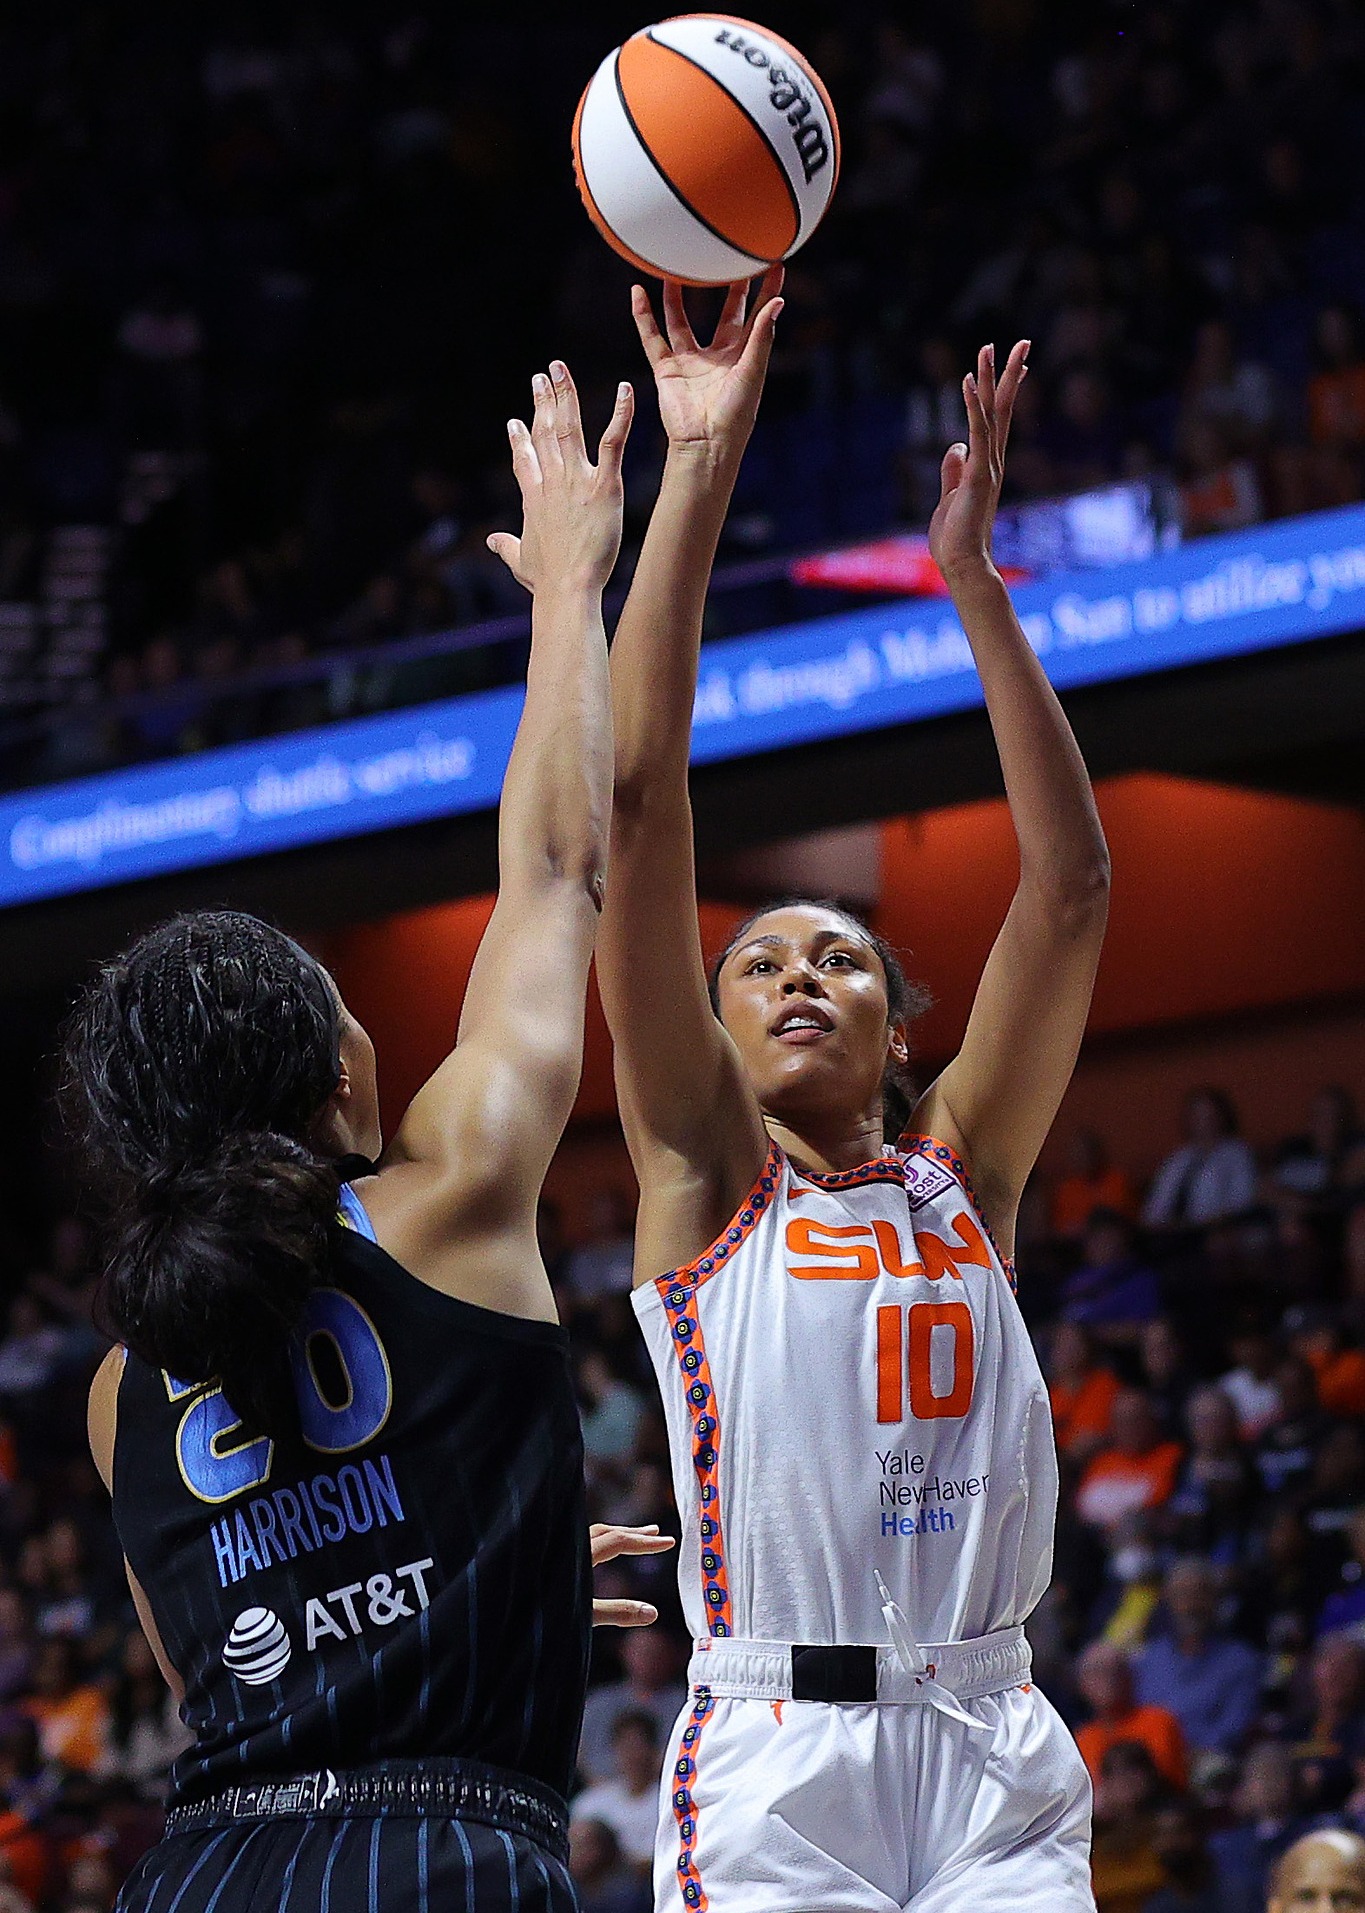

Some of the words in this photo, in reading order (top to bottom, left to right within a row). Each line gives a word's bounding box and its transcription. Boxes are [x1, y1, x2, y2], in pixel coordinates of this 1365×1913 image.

[714, 29, 829, 186] Wilson
[1133, 584, 1181, 635] to
[906, 1170, 942, 1197] ost
[785, 1211, 991, 1282] SUN
[876, 1303, 975, 1424] 10
[875, 1449, 924, 1475] Yale
[210, 1455, 405, 1588] HARRISON
[306, 1557, 434, 1652] AT&T
